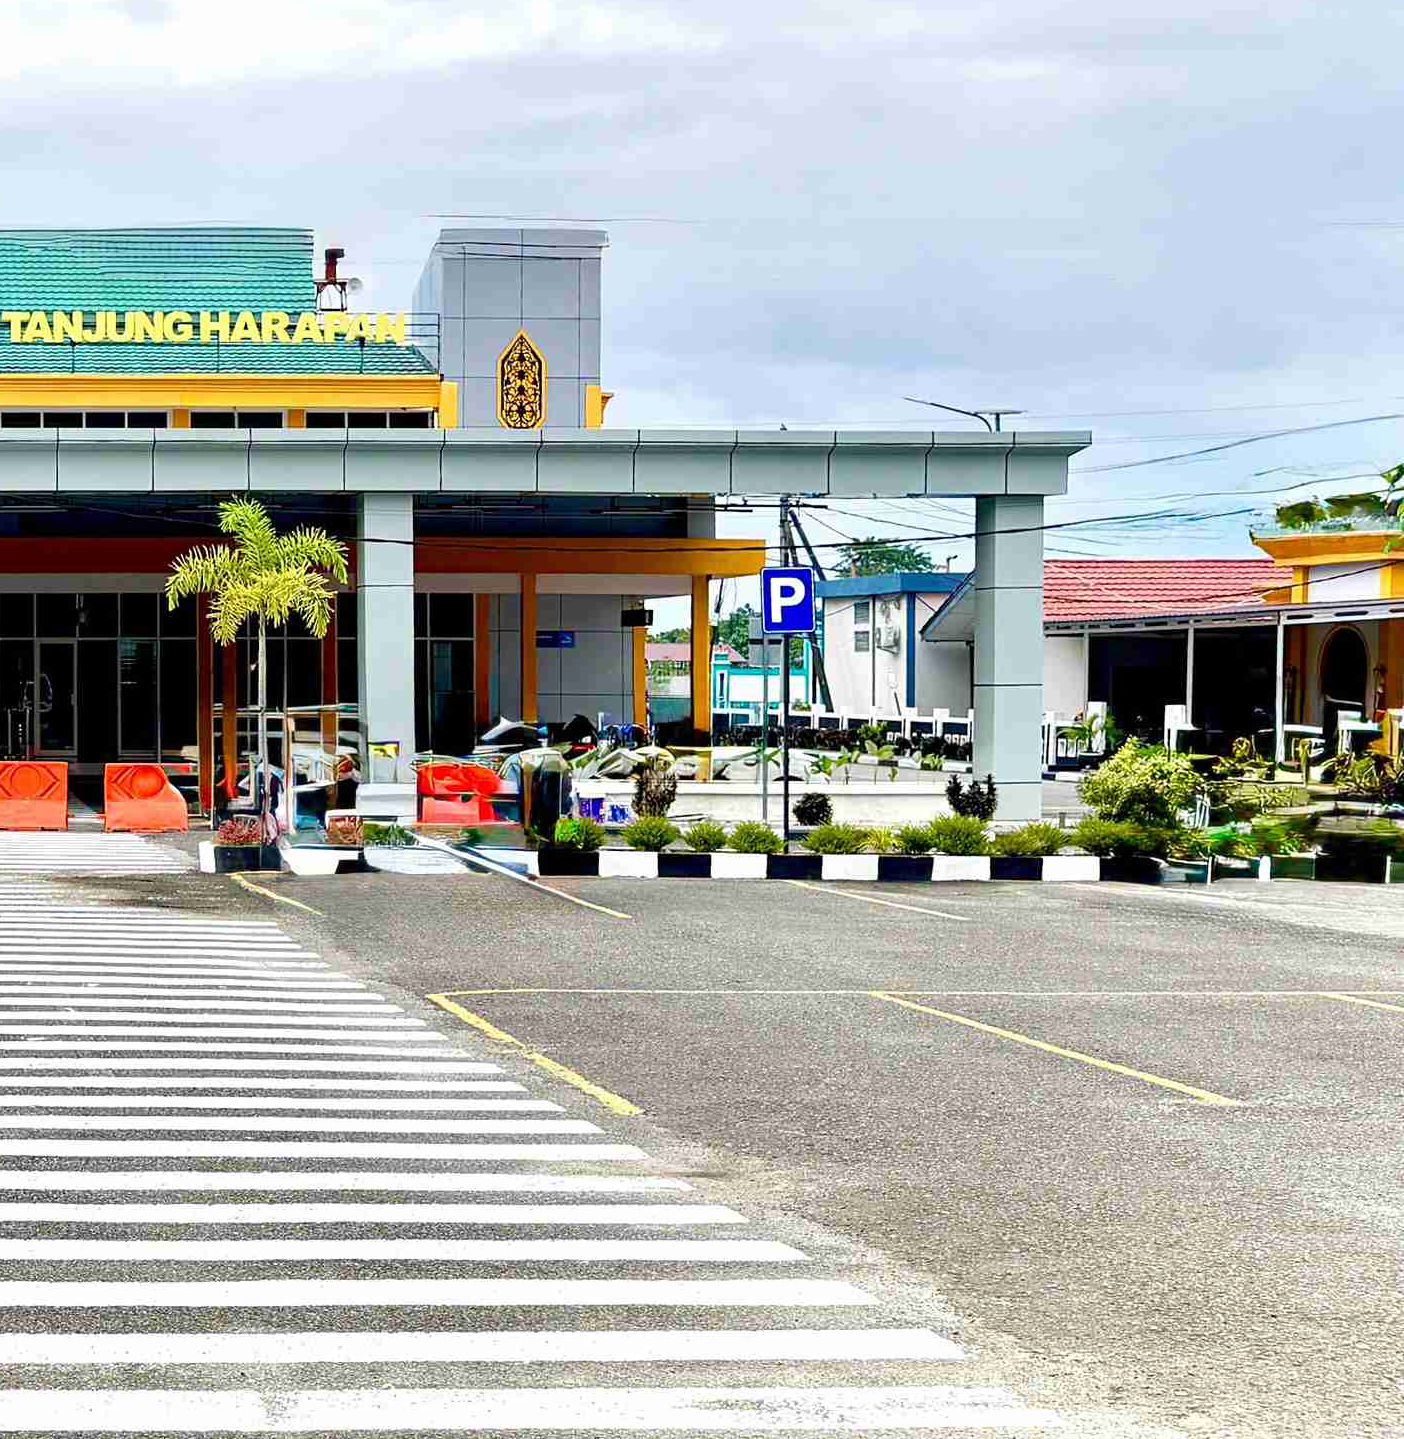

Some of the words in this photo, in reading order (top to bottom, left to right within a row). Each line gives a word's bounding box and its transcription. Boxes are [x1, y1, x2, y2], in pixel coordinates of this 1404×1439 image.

[1, 310, 192, 344] TANJUNG
[199, 310, 405, 344] HARAPAN
[770, 577, 806, 623] P
